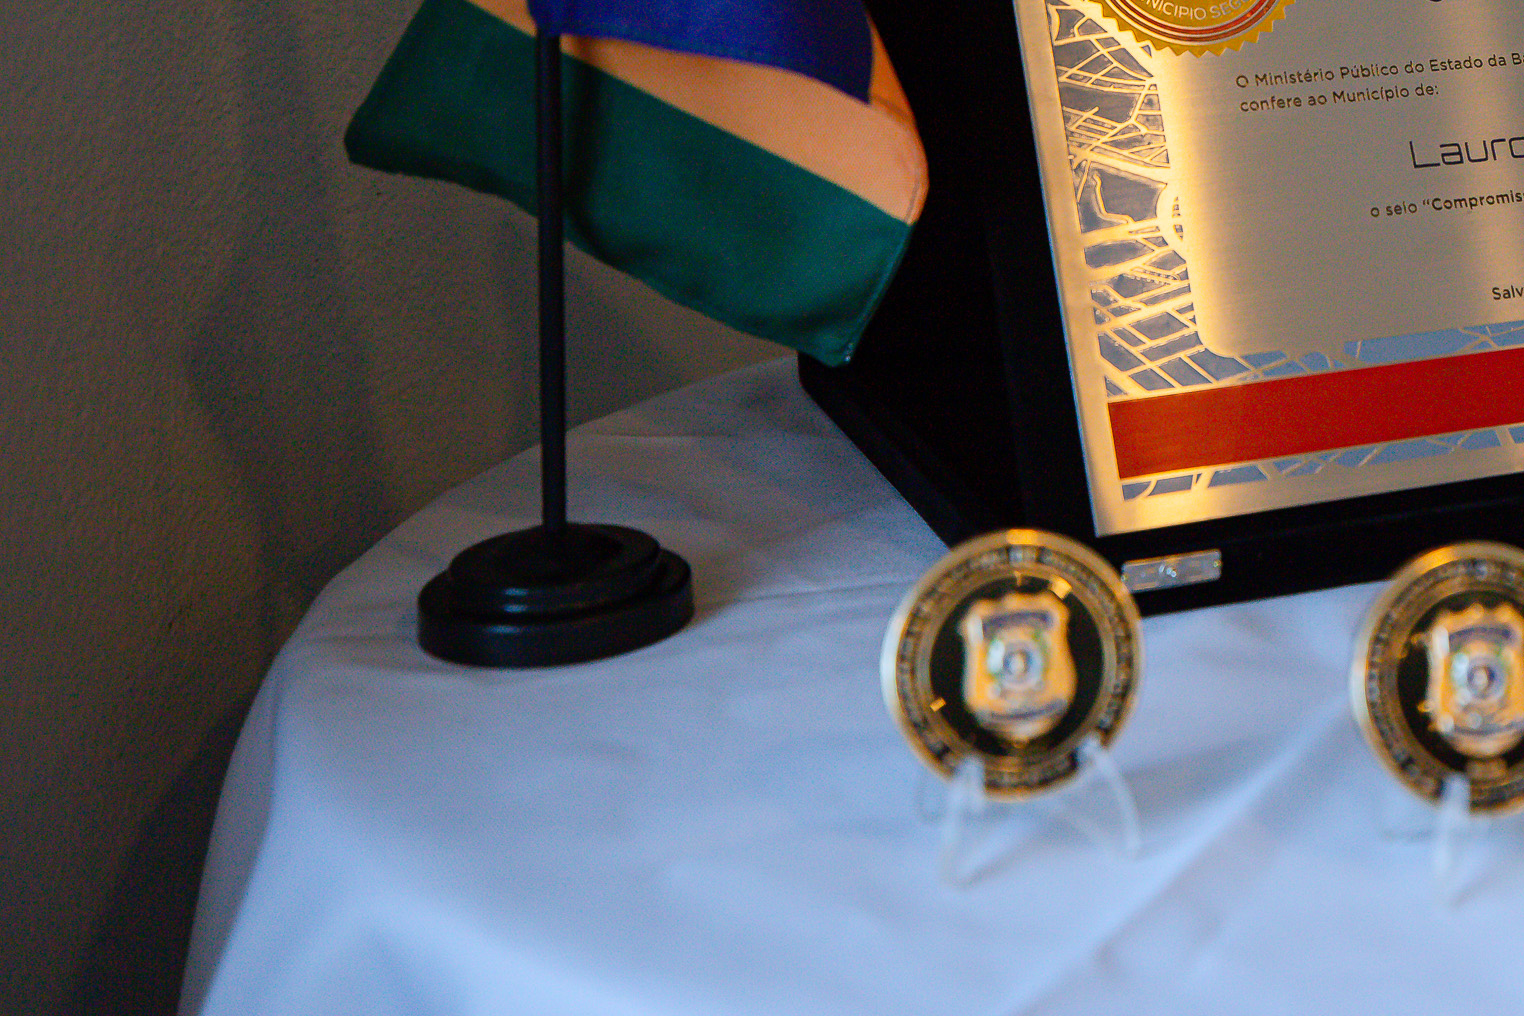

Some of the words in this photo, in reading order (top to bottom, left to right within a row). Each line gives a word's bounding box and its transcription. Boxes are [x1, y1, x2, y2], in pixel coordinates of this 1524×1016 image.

[1235, 74, 1249, 88] O
[1255, 68, 1335, 87] Ministério
[1339, 63, 1399, 81] Público
[1404, 60, 1425, 75] do
[1429, 55, 1483, 73] Estado
[1487, 53, 1507, 68] da
[1240, 93, 1302, 112] confere
[1307, 93, 1327, 106] ao
[1332, 86, 1410, 104] Município
[1414, 82, 1440, 97] de:
[1370, 205, 1380, 218] o
[1385, 199, 1418, 217] selo
